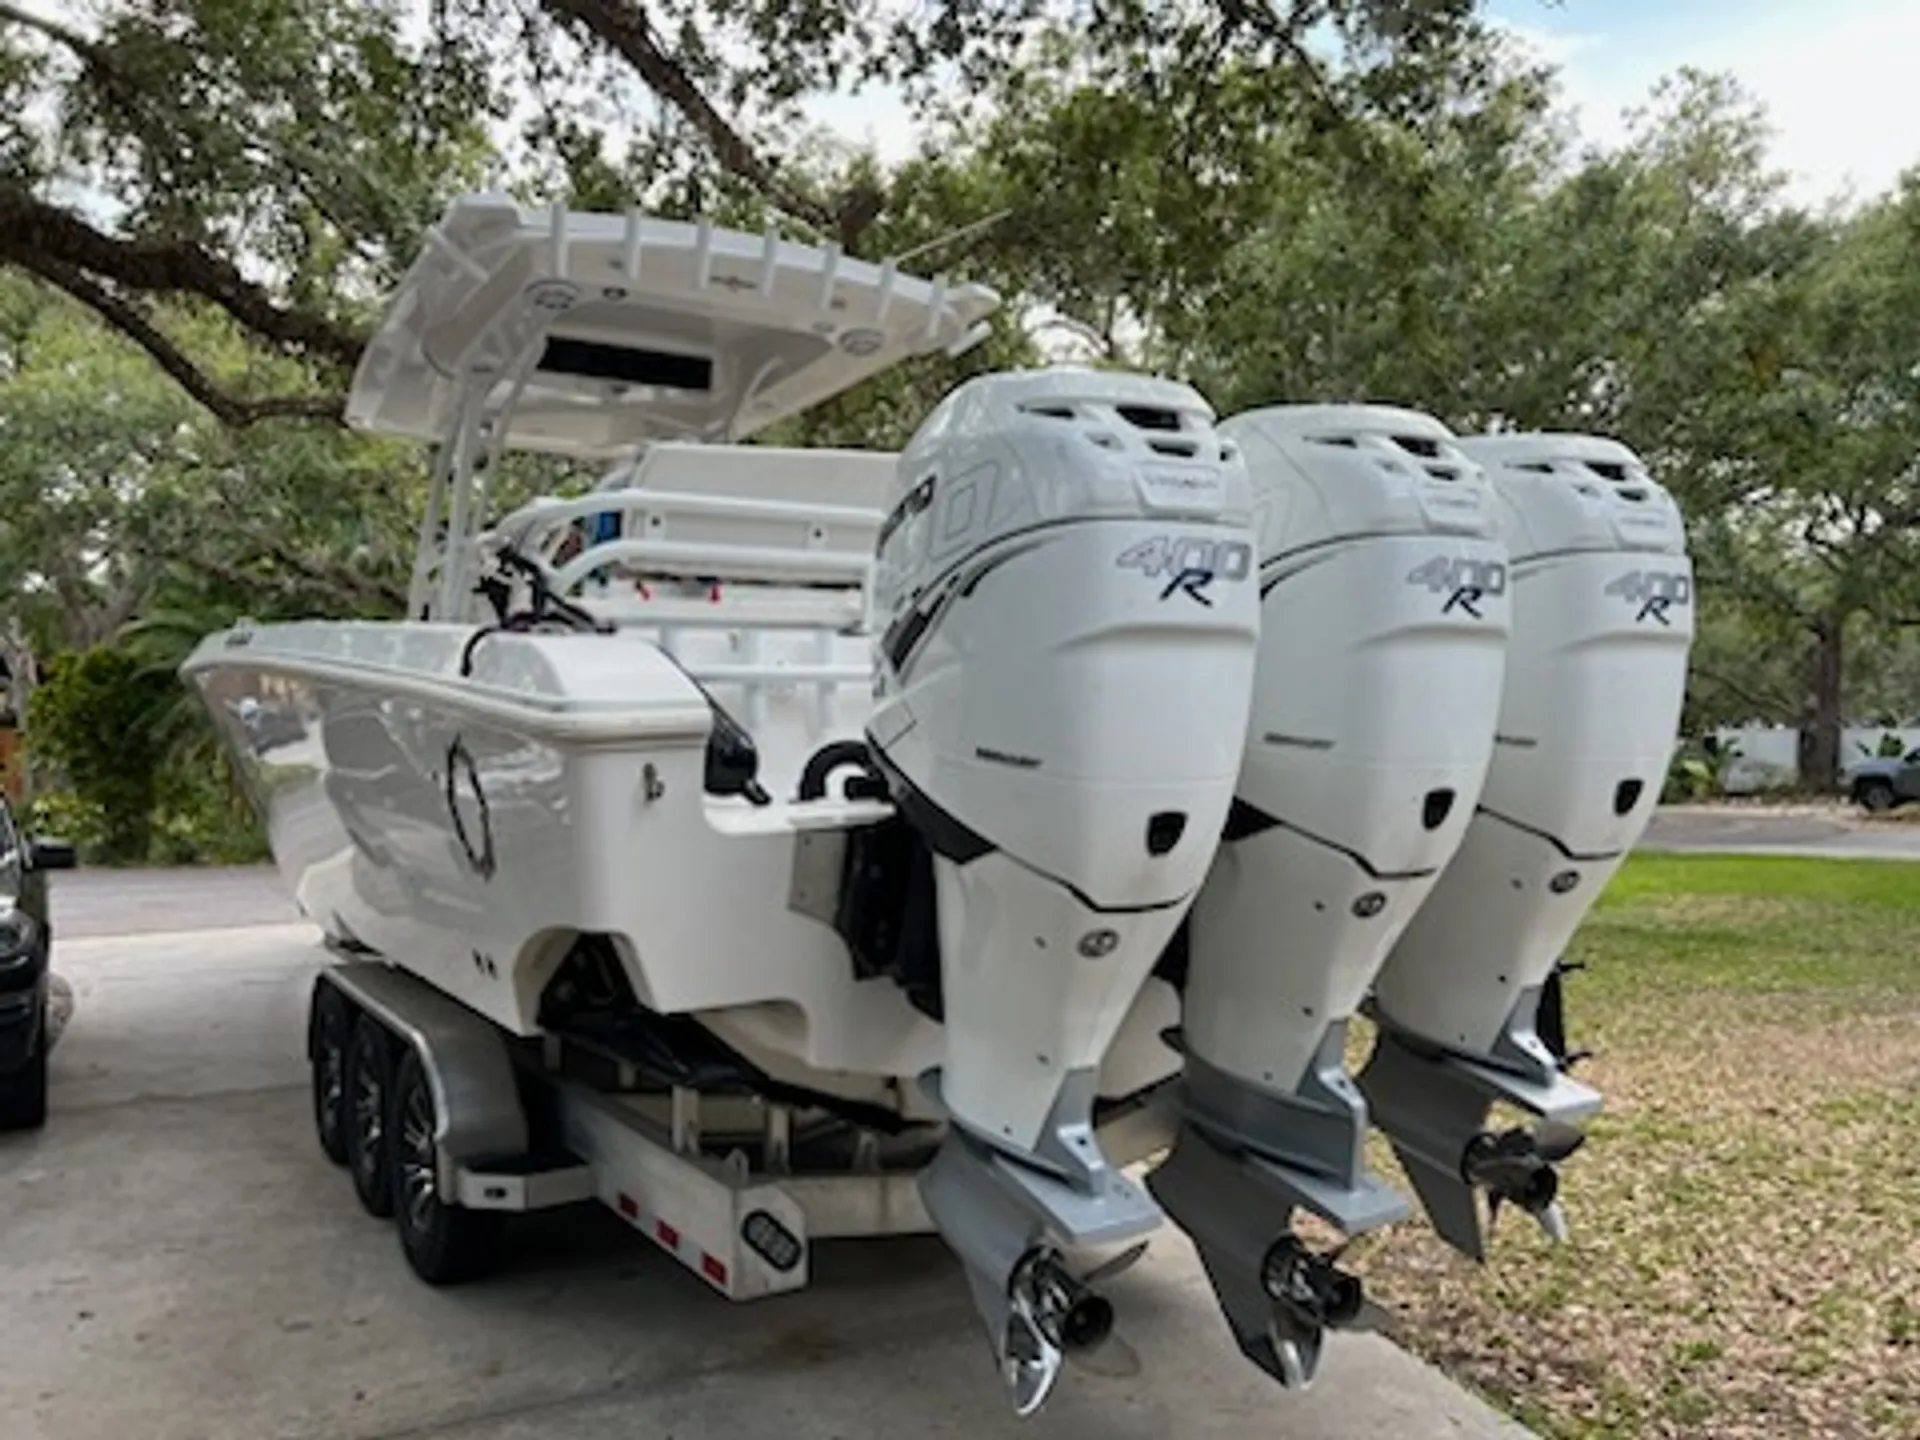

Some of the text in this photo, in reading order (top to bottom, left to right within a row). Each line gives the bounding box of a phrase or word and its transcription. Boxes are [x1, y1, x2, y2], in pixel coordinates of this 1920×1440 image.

[1115, 534, 1252, 581] 400
[1405, 556, 1506, 597] 400
[1159, 567, 1214, 608] R
[1441, 586, 1483, 620] R
[1604, 570, 1690, 606] 400
[1635, 596, 1670, 626] R
